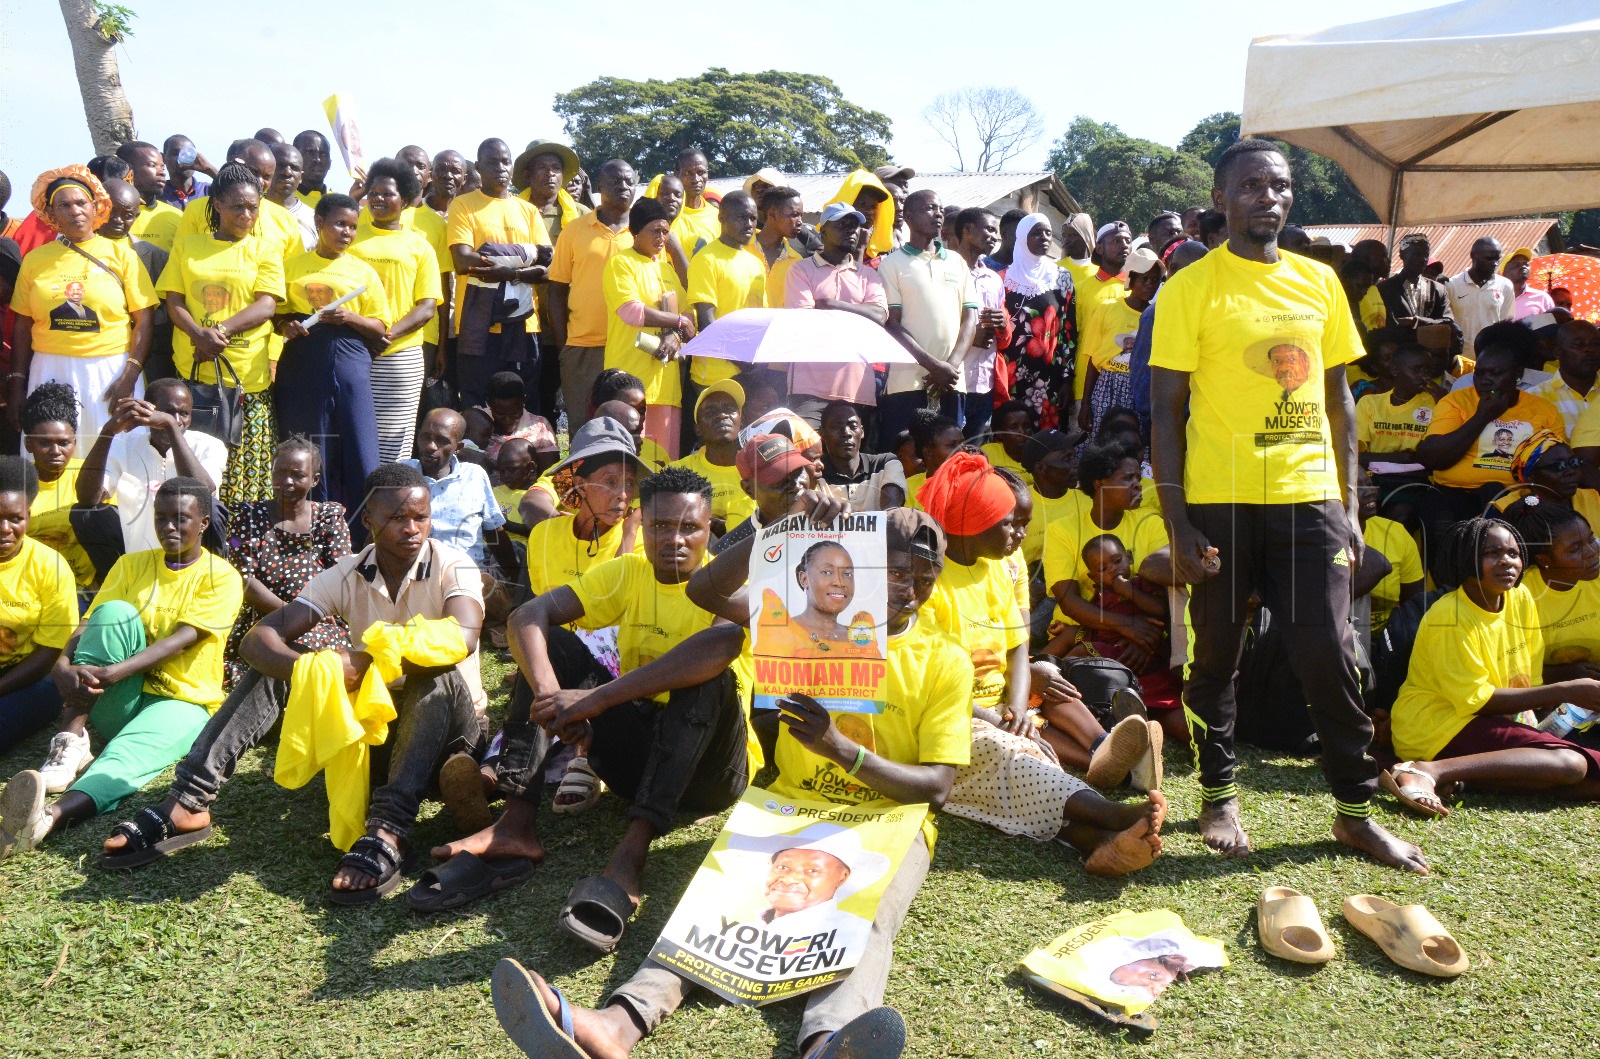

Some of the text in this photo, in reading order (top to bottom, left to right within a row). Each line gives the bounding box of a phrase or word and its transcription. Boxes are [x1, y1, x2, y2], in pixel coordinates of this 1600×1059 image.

[1271, 314, 1315, 322] PRESIDENT
[1274, 401, 1320, 416] YOWERI
[1265, 415, 1323, 430] MUSEVENI
[1373, 421, 1428, 433] SETTLE FOR THE BEST
[839, 514, 877, 532] IDAH
[1552, 614, 1589, 630] PRESIDENT
[755, 660, 886, 688] WOMAN MP
[763, 685, 877, 699] KALANGALA DISTRICT
[797, 807, 884, 823] PRESIDENT
[720, 914, 838, 956] YOWERI
[1053, 919, 1112, 959] PRESIDENT
[684, 924, 847, 977] MUSEVENI
[657, 952, 666, 960] AS
[666, 956, 676, 965] WE
[677, 961, 694, 974] MAKE
[698, 973, 735, 994] QUALITATIVE
[735, 990, 751, 1000] LEAP
[674, 949, 763, 994] PROTECTING
[767, 981, 793, 994] THE
[795, 972, 837, 988] GAINS
